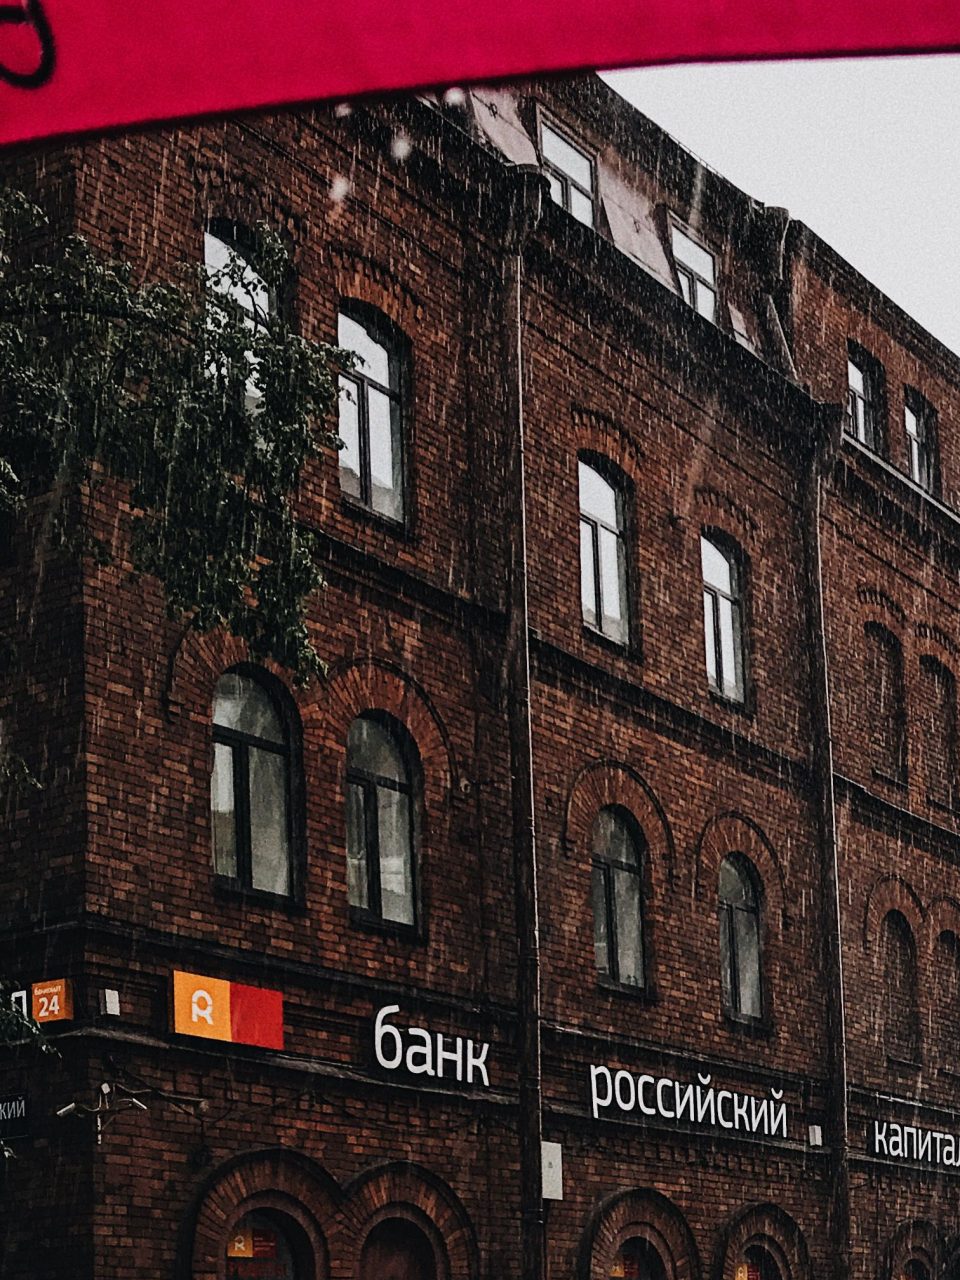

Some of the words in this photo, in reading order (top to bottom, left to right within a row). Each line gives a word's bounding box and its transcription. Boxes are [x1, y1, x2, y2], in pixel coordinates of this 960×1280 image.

[38, 995, 60, 1017] 24
[374, 1004, 490, 1087] банк
[589, 1064, 788, 1138] российский
